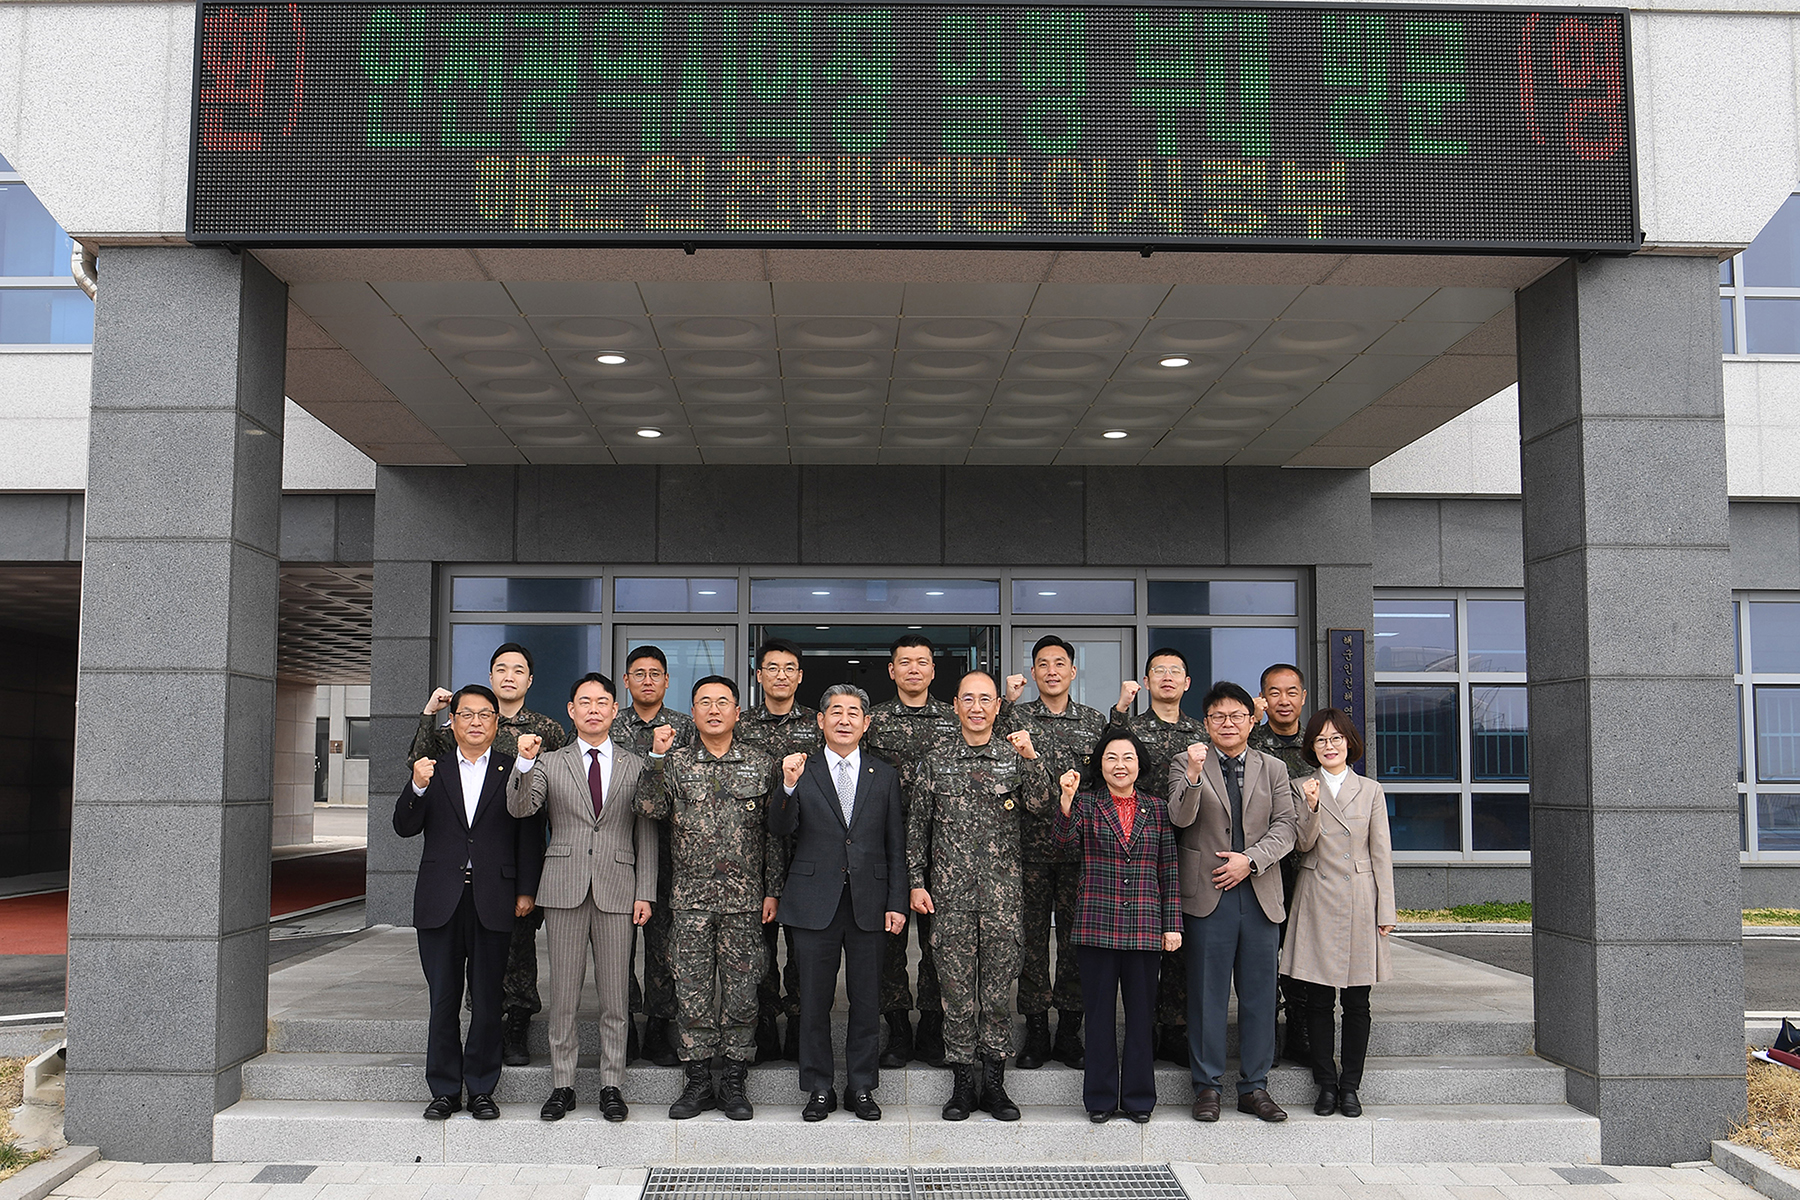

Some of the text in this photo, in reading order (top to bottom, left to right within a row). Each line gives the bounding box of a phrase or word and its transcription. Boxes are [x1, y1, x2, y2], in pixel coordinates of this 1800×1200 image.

[359, 8, 897, 152] 인천광역시의장
[937, 11, 1087, 154] 일행
[1131, 12, 1272, 156] 부대
[1321, 15, 1469, 157] 방문
[474, 154, 1352, 240] 해군인천해역방어사령부
[1342, 634, 1354, 719] 해군인천해역
